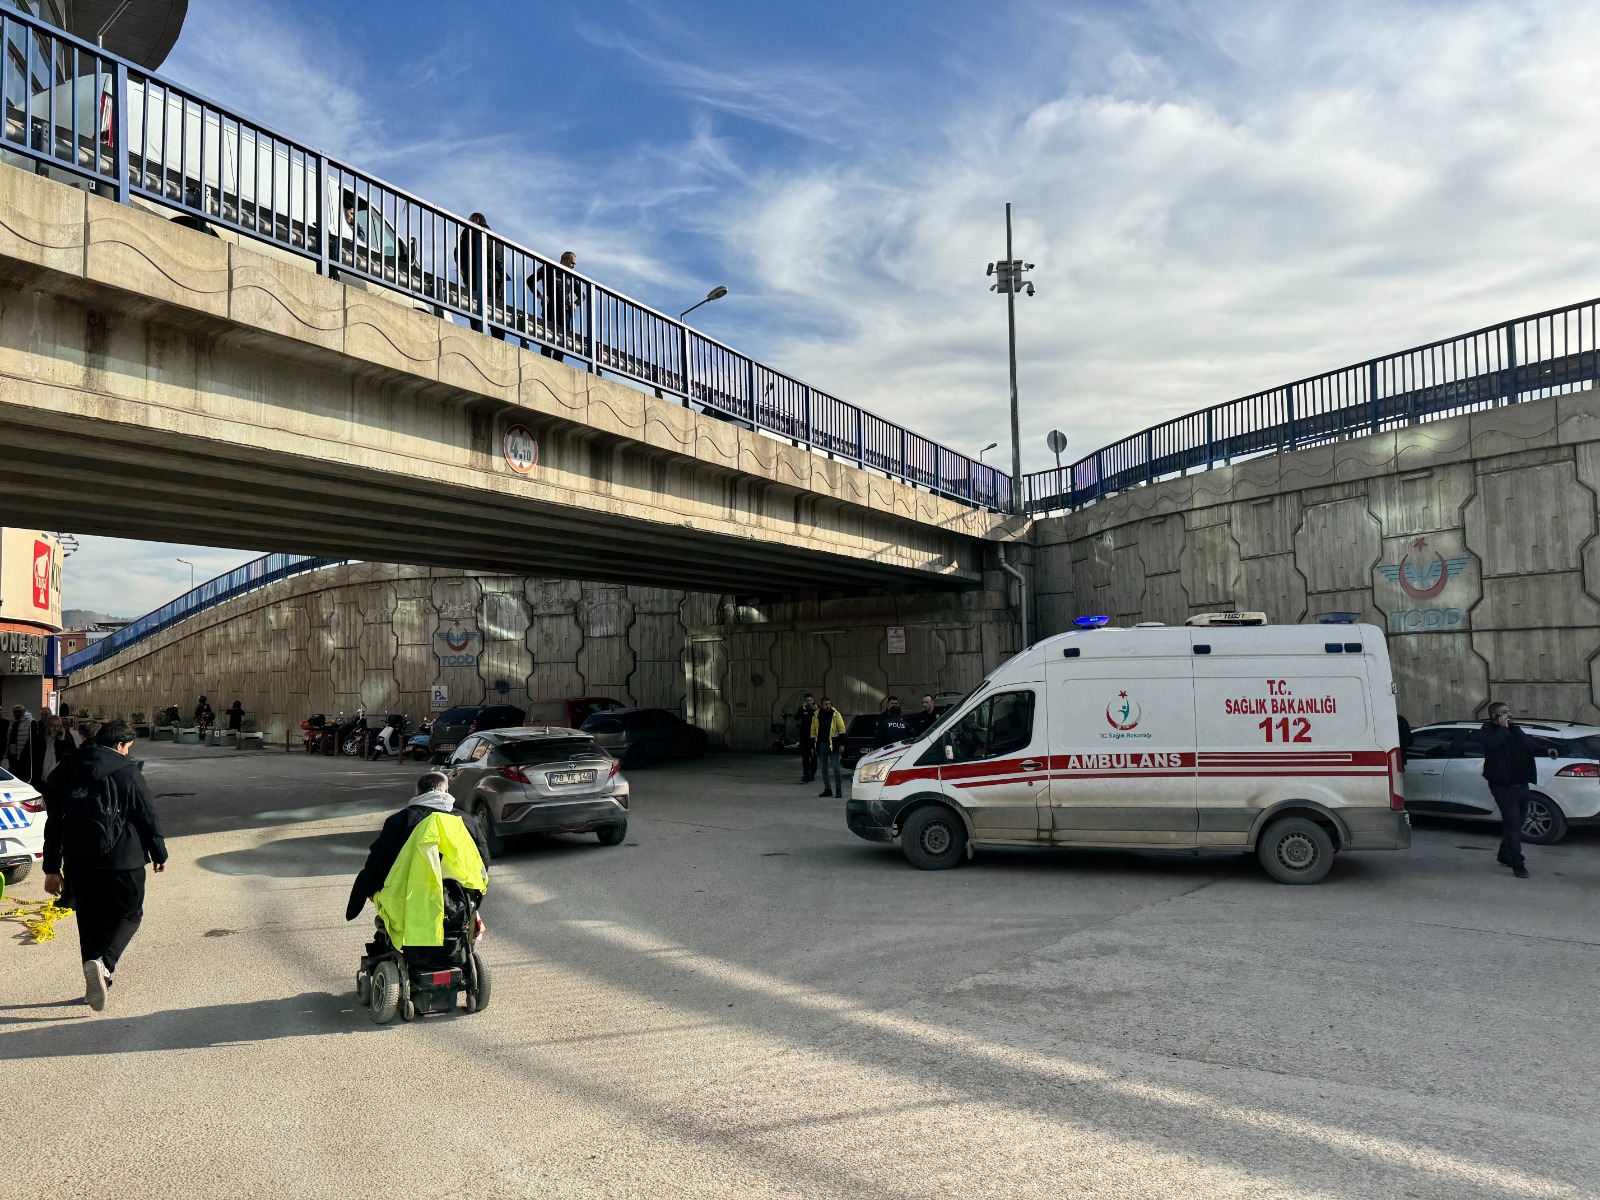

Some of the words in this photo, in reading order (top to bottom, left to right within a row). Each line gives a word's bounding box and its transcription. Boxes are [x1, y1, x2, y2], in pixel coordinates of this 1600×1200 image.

[1389, 608, 1466, 632] TCDD
[441, 655, 476, 665] TCDD
[434, 690, 442, 701] P
[1266, 679, 1292, 696] T.C.
[1225, 695, 1268, 715] SAĞLIK
[1271, 694, 1337, 714] BAKANLIĞI
[1258, 717, 1313, 743] 112
[1067, 753, 1182, 769] AMBULANS
